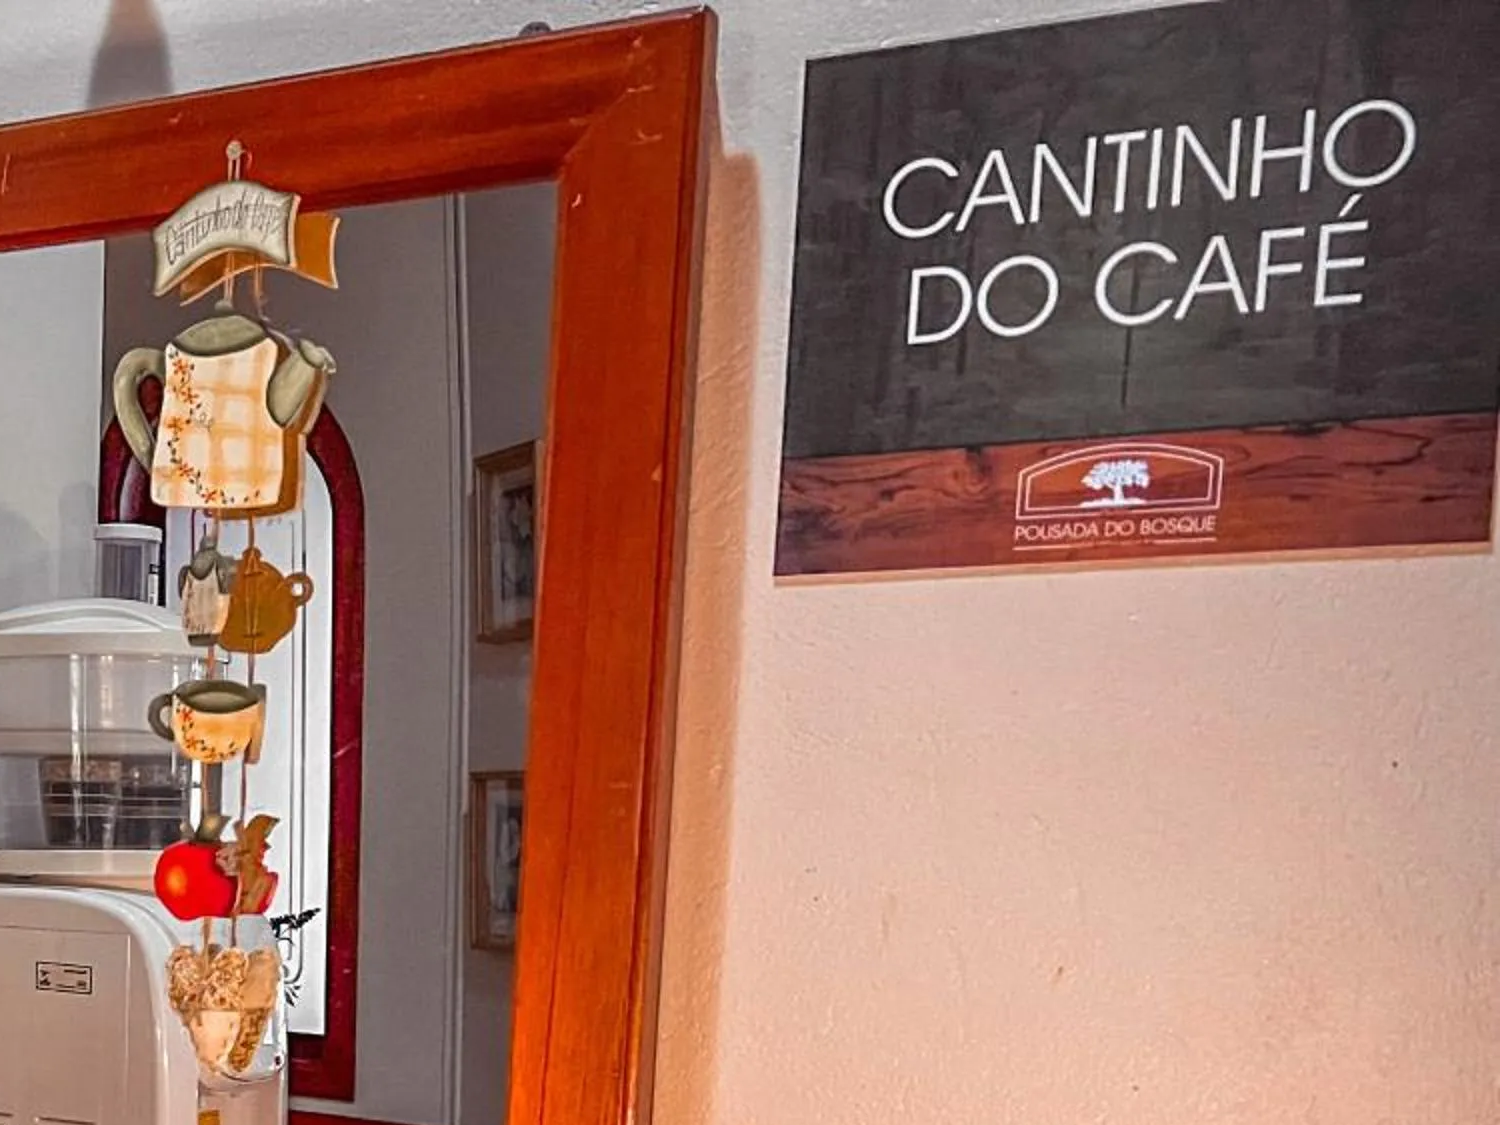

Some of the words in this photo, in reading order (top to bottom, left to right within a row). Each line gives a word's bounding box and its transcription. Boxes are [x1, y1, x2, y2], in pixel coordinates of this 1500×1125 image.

[882, 98, 1417, 240] CANTINHO
[906, 254, 1060, 345] DO
[1094, 193, 1370, 326] CAFÉ
[1014, 520, 1100, 542] POUSADA
[1103, 518, 1136, 538] DO
[1139, 514, 1218, 536] BOSQUE
